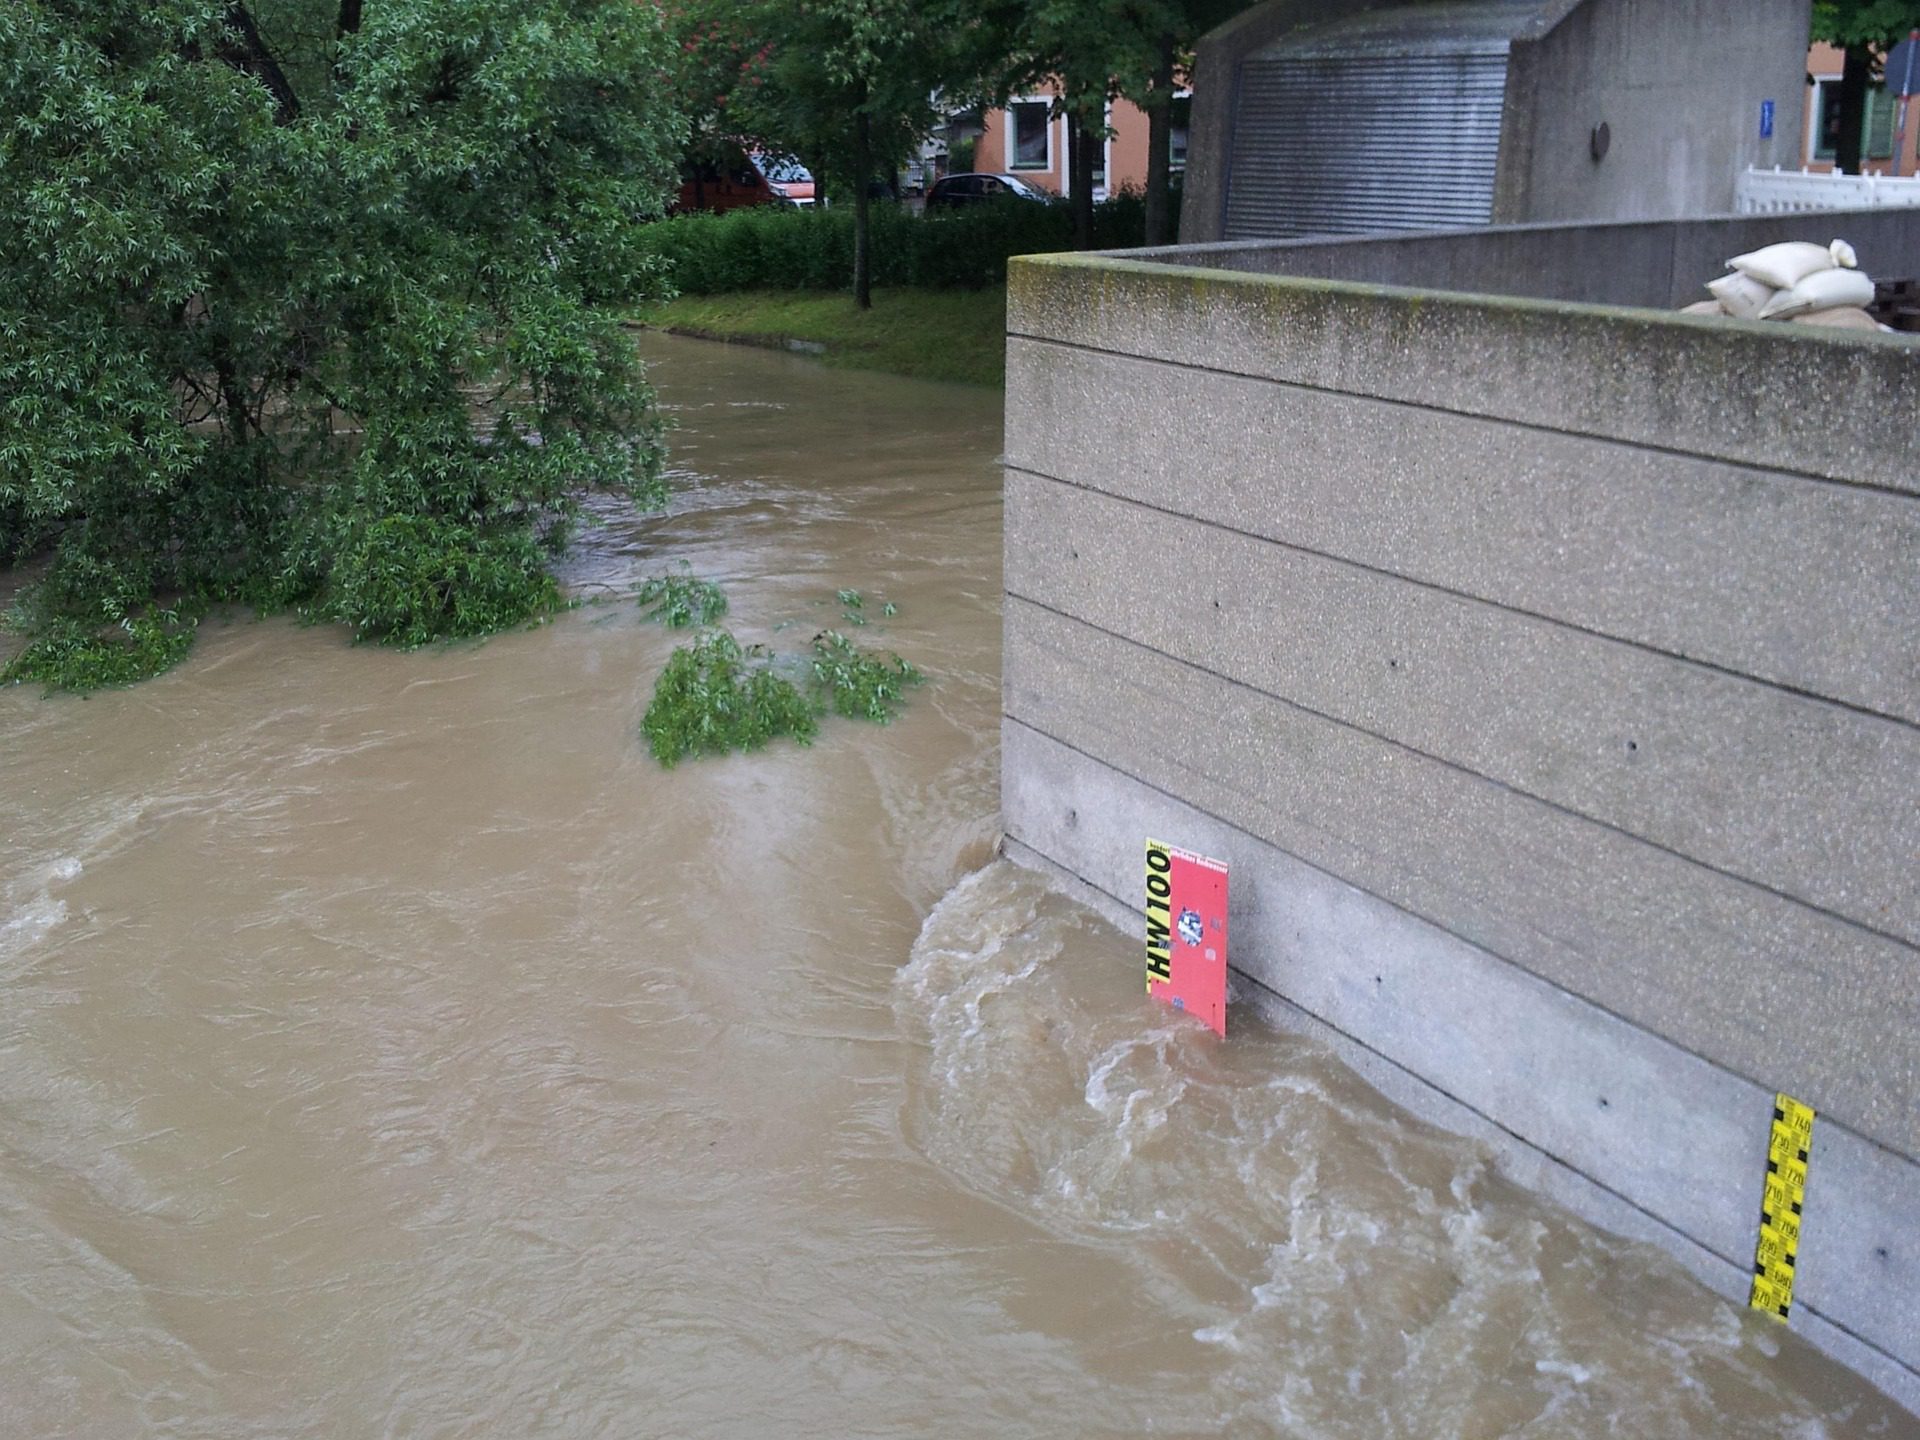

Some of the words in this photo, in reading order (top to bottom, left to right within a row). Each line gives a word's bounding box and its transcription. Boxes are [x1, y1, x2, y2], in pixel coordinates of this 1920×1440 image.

[1147, 849, 1171, 912] 100
[1147, 912, 1171, 980] HW
[1795, 1116, 1811, 1133] 740
[1773, 1133, 1790, 1149] 730
[1788, 1169, 1804, 1186] 720
[1766, 1185, 1783, 1202] 710
[1781, 1221, 1798, 1239] 700
